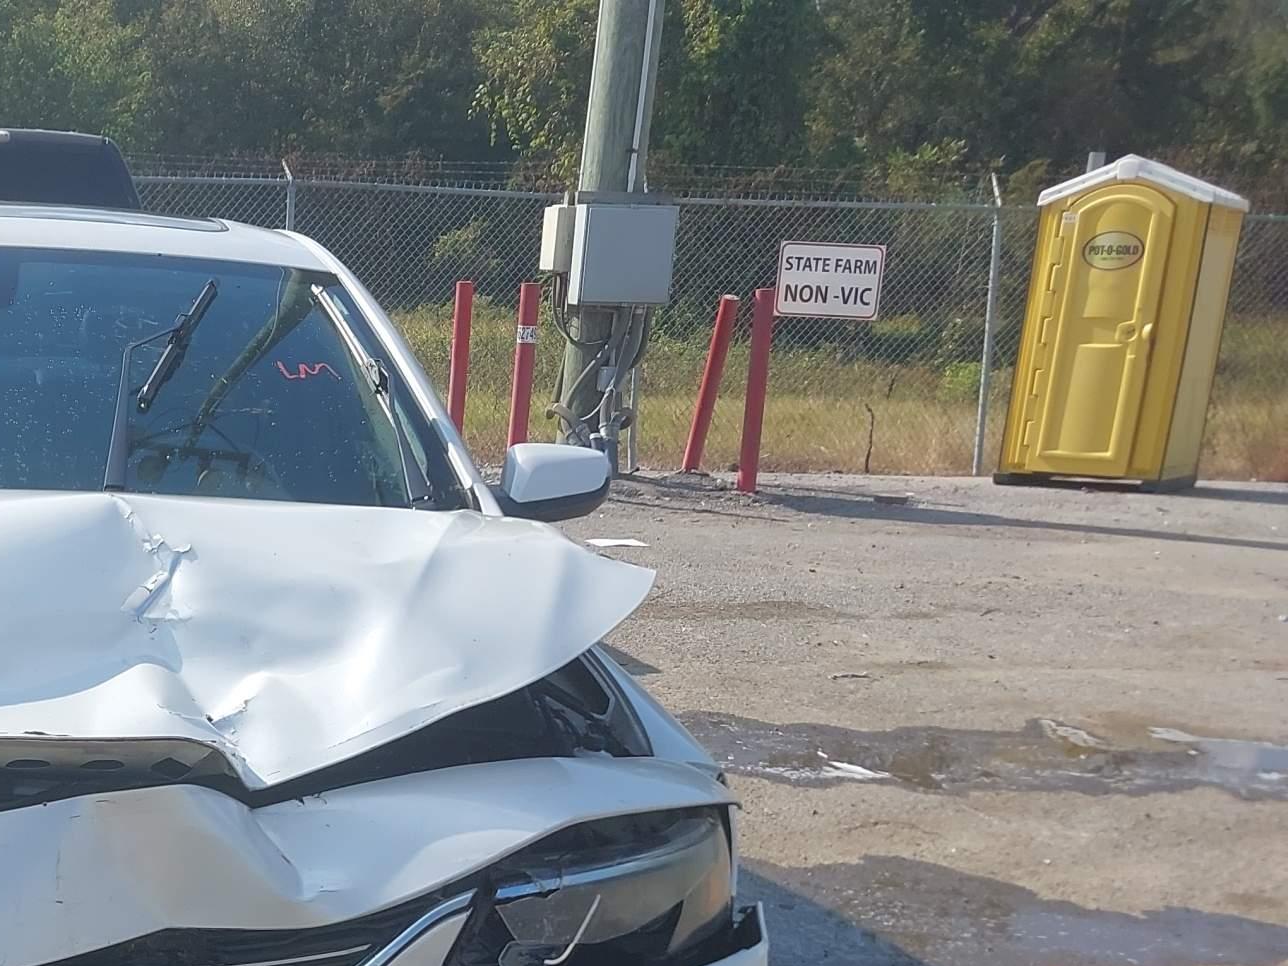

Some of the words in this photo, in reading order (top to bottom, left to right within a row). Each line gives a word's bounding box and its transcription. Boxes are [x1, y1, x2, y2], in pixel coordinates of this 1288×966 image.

[1088, 244, 1139, 256] POT-O-GOLD
[784, 256, 830, 272] STATE
[834, 258, 878, 275] FARM
[784, 284, 829, 303] NON
